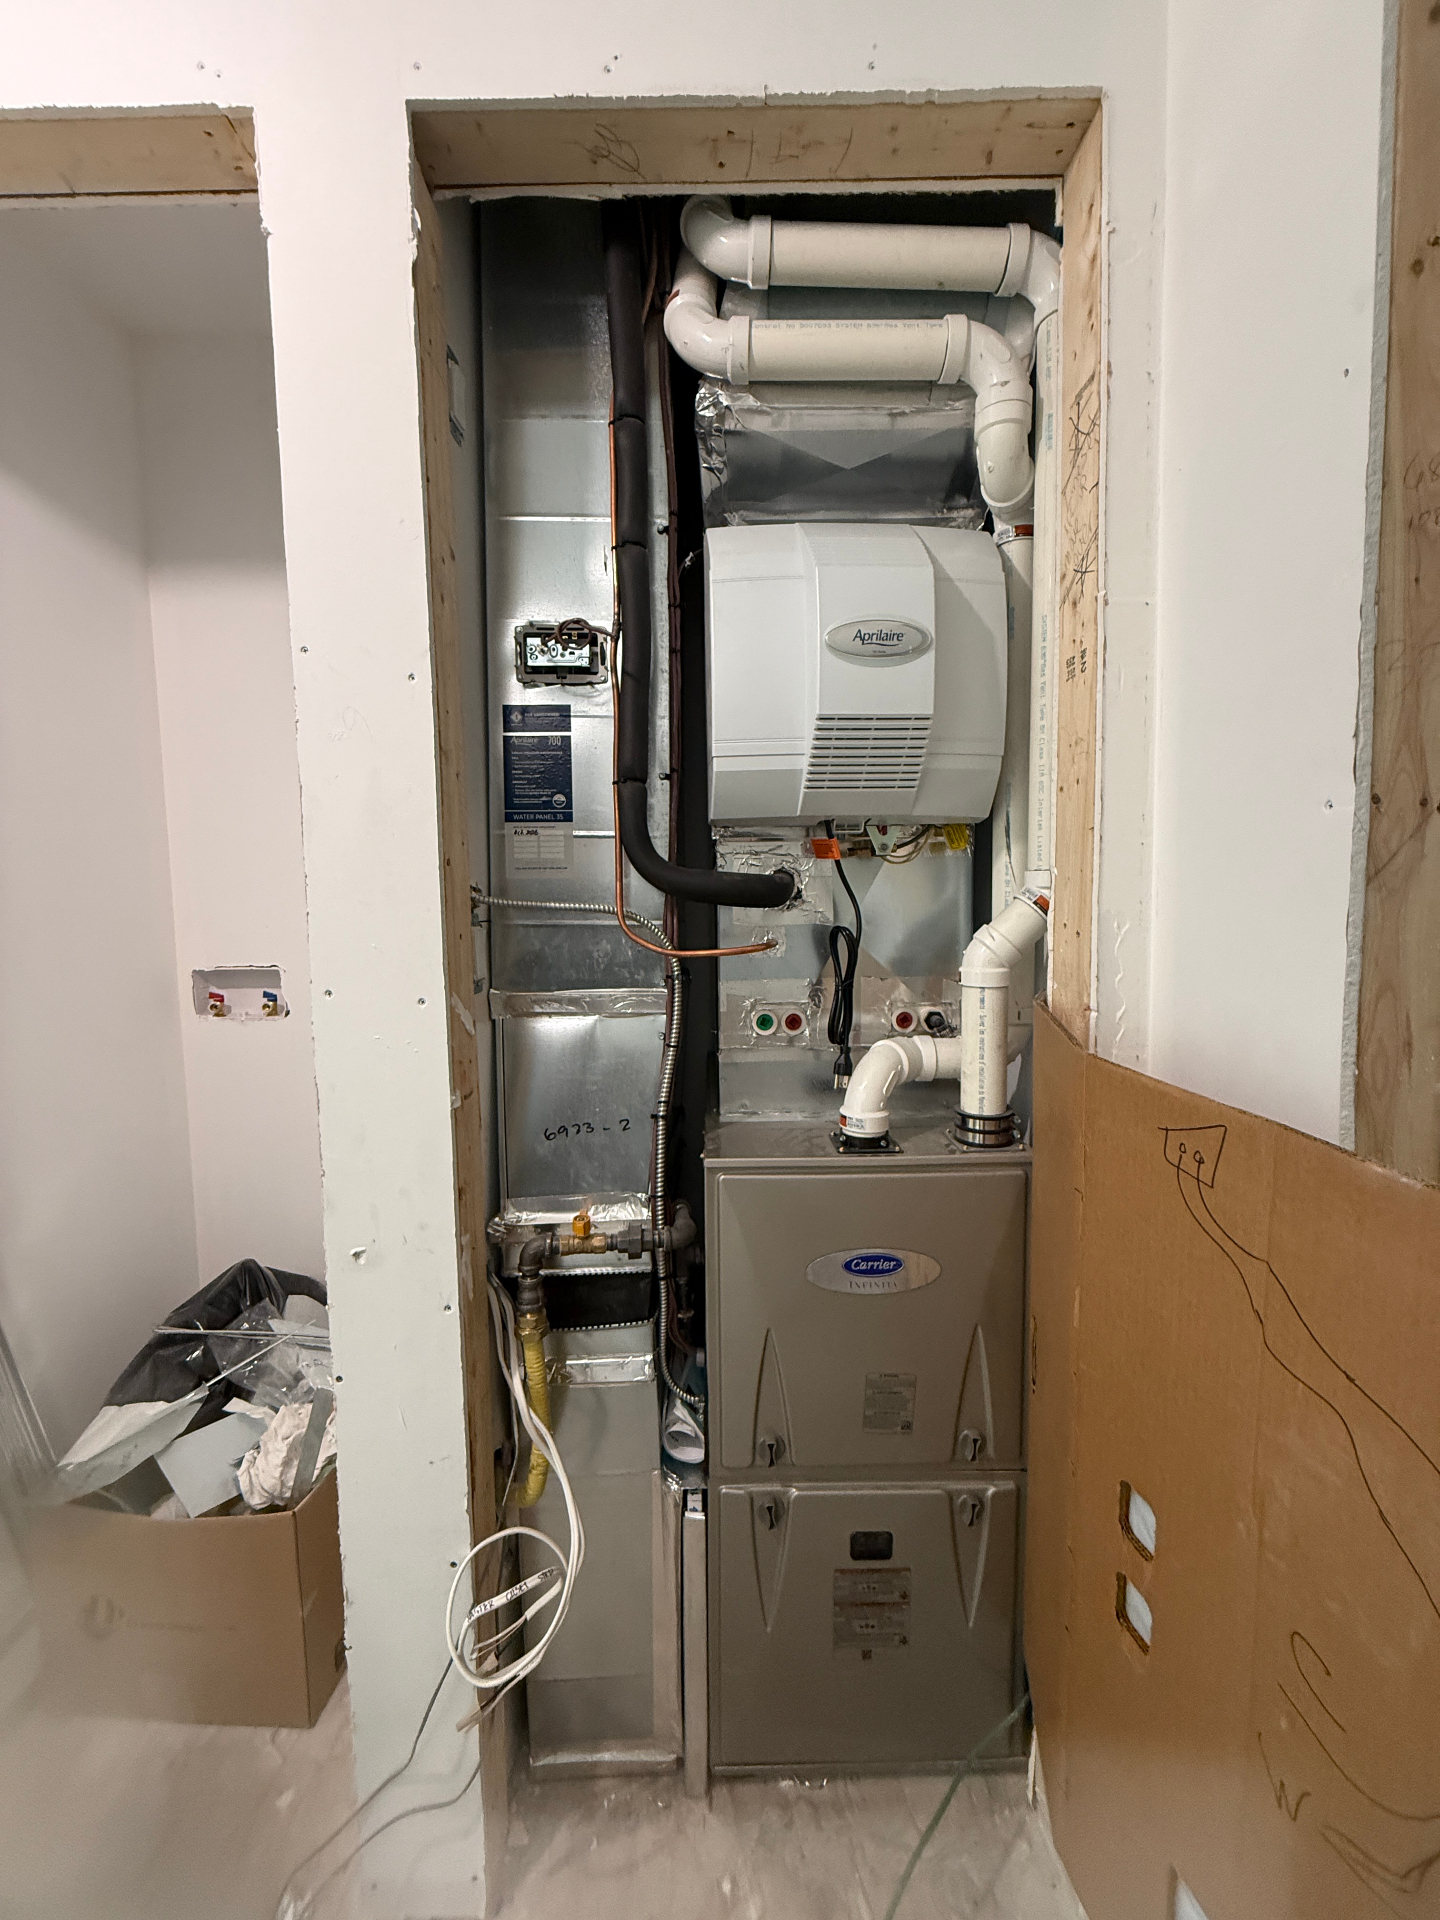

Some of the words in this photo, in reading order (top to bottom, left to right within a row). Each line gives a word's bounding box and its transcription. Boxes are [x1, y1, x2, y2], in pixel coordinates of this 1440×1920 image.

[852, 628, 904, 646] Aprilaire
[548, 736, 562, 746] 700
[1036, 835, 1044, 862] Listed
[851, 1258, 897, 1271] Carrier
